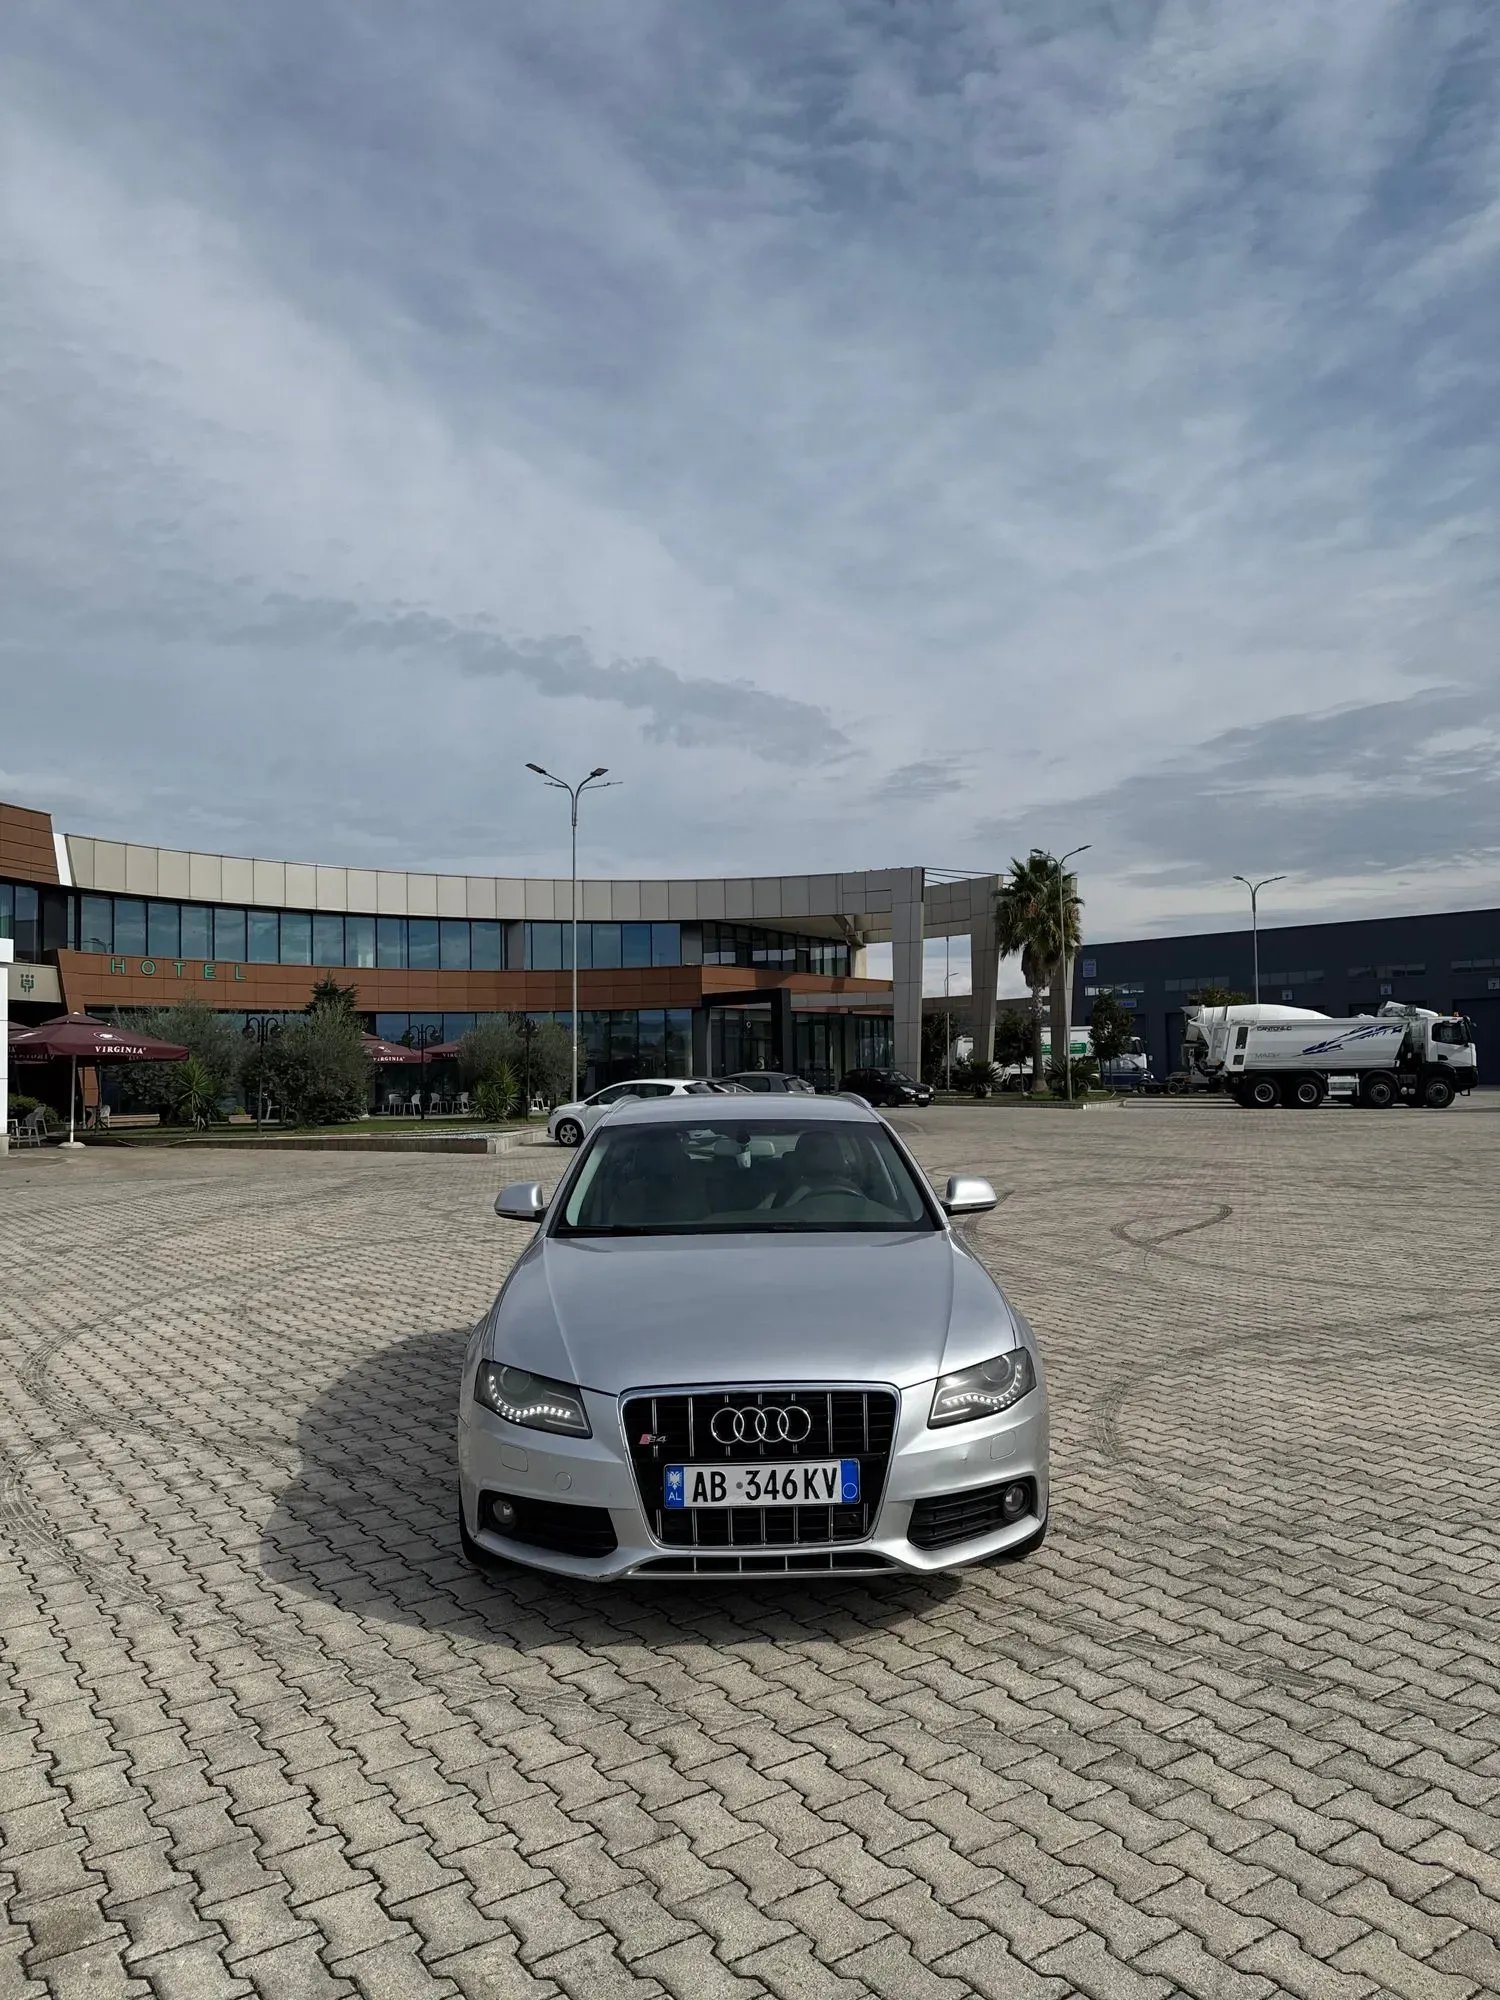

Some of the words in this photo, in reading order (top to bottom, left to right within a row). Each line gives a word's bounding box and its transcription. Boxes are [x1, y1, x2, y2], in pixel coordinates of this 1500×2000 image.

[110, 958, 247, 980] HOTEL
[95, 1045, 144, 1055] VIRGINIA
[692, 1471, 727, 1503] AB
[668, 1491, 682, 1501] AL
